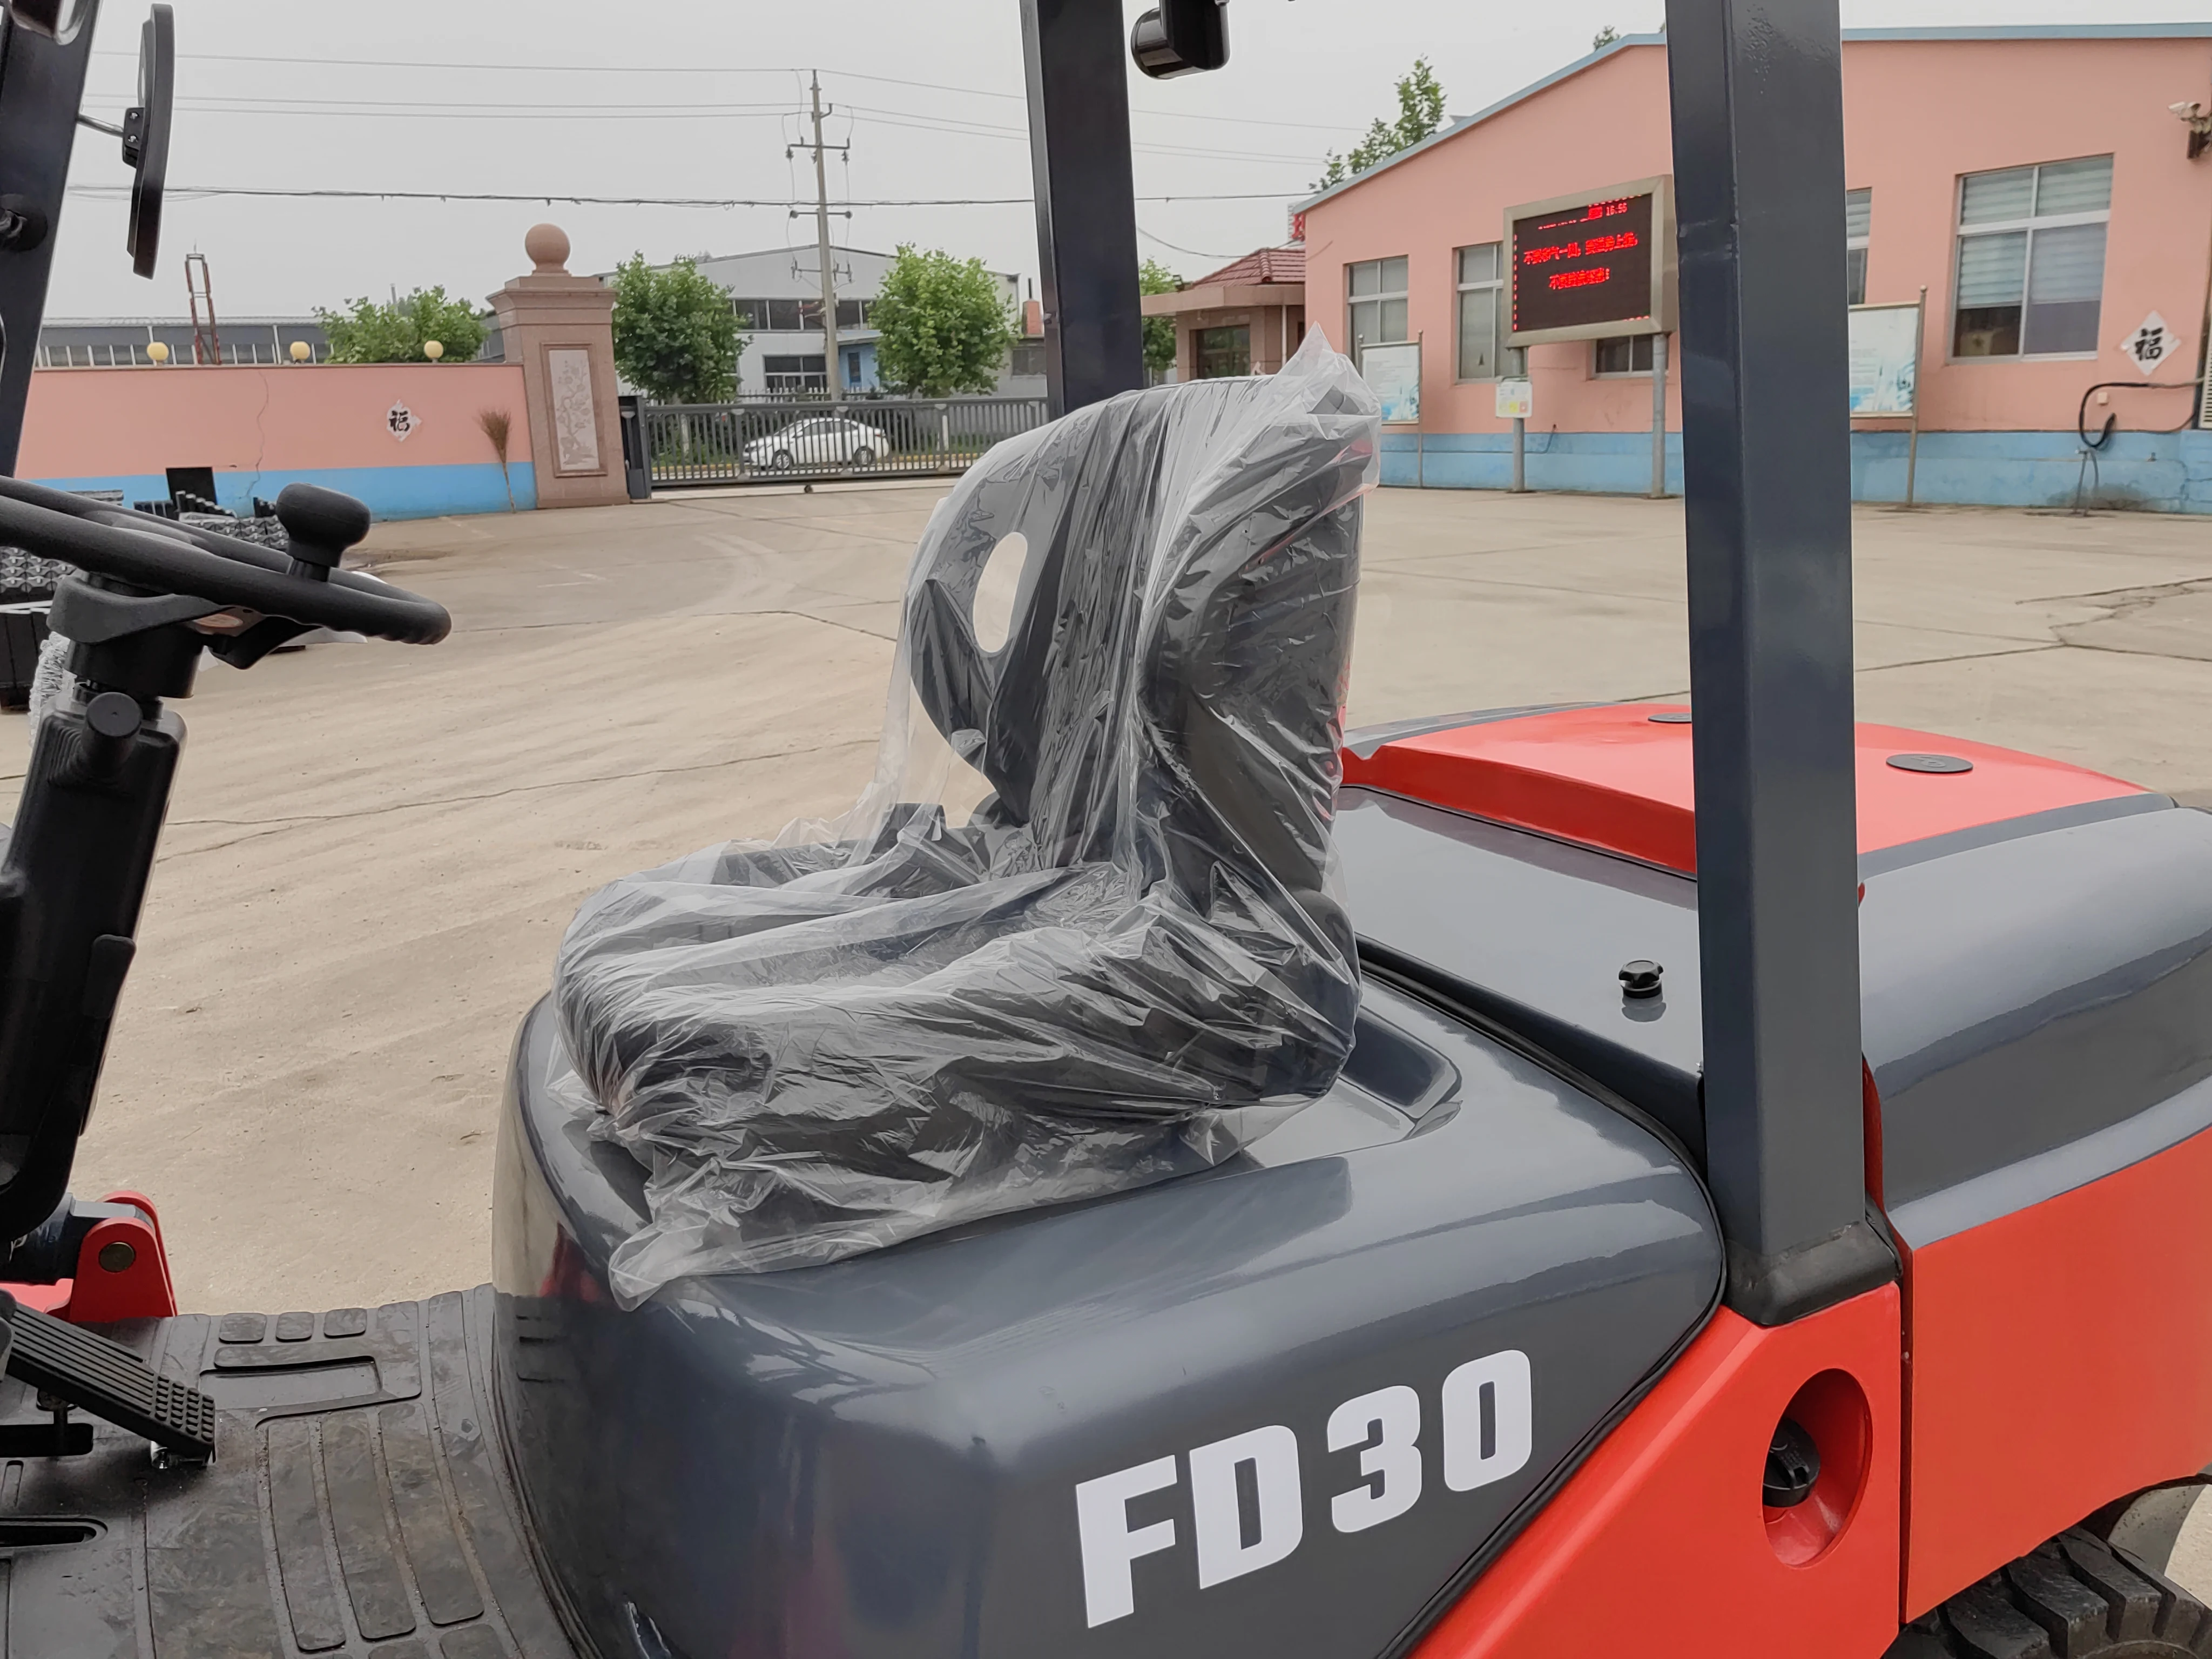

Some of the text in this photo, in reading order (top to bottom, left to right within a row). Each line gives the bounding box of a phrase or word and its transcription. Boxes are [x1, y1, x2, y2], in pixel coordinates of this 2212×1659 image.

[2134, 327, 2163, 361] 福
[389, 410, 410, 432] 福
[1076, 1350, 1532, 1628] FD30
